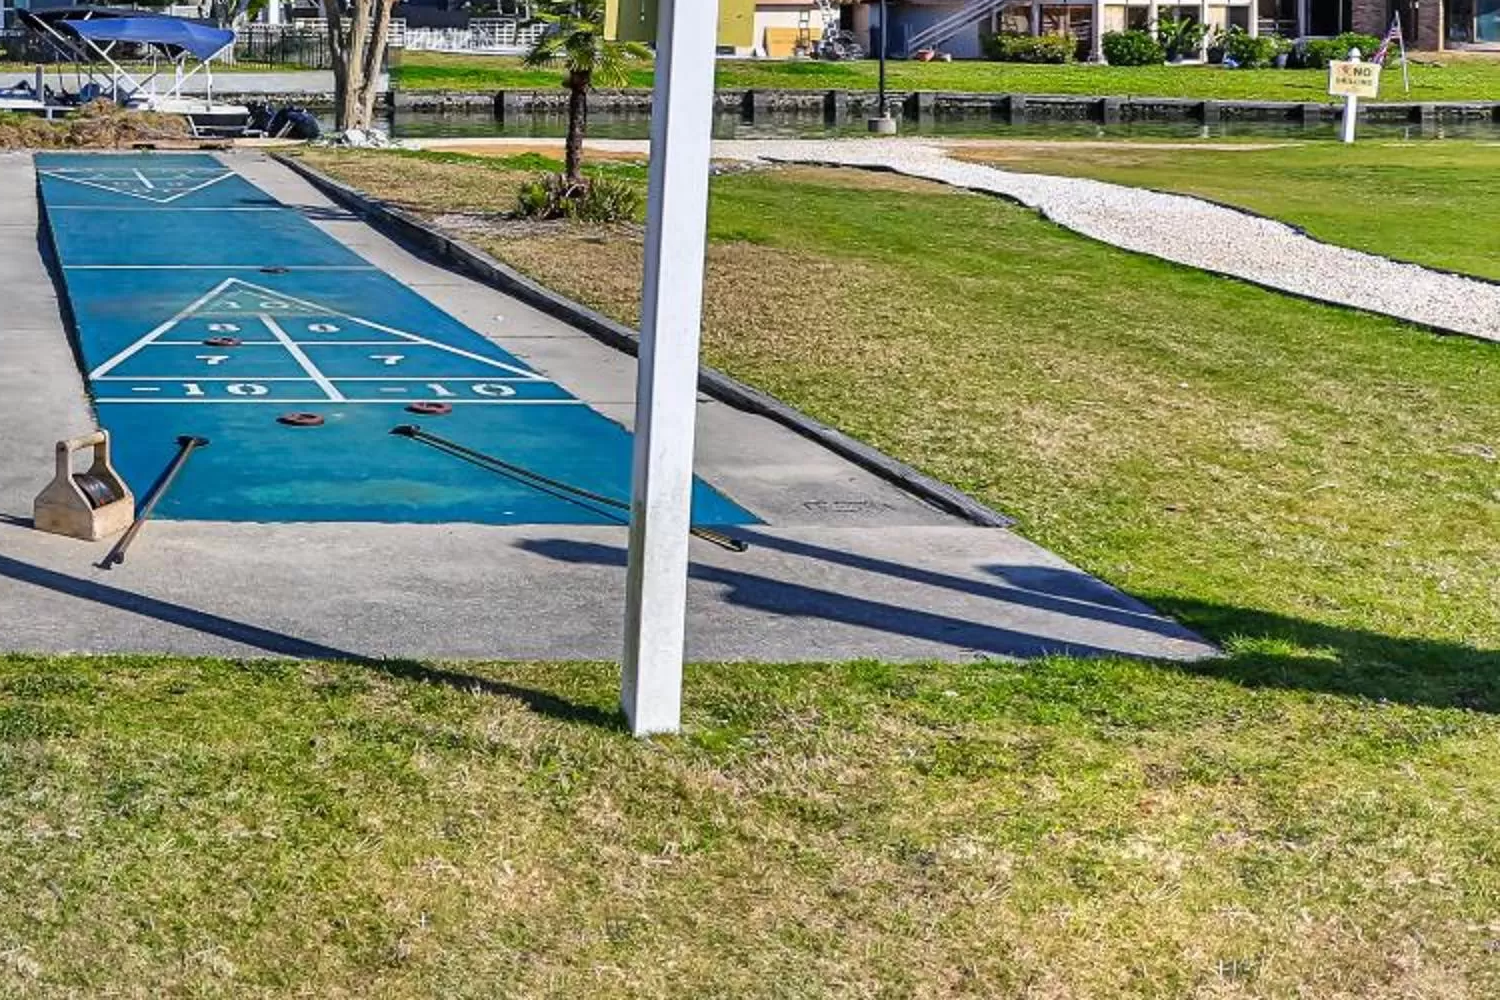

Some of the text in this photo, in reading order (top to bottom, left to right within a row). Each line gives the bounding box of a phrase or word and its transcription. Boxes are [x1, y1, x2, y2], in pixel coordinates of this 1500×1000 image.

[1353, 67, 1372, 77] NO
[195, 354, 229, 366] 7
[369, 354, 405, 366] 7
